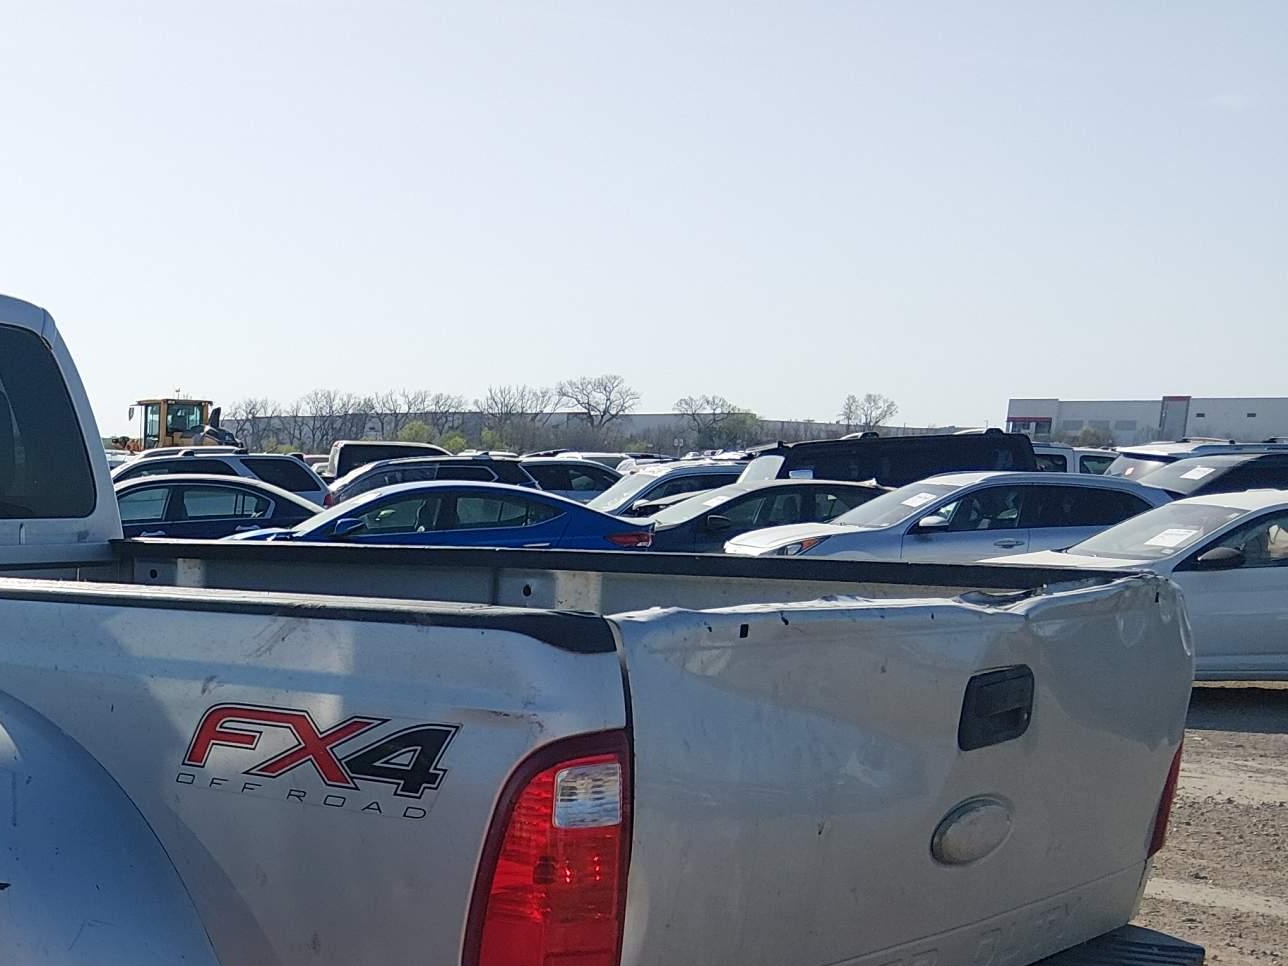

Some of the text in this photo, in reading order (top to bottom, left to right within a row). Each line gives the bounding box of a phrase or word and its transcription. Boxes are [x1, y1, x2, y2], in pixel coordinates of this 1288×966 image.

[181, 701, 463, 800] FX4
[175, 772, 428, 820] OFF ROAD
